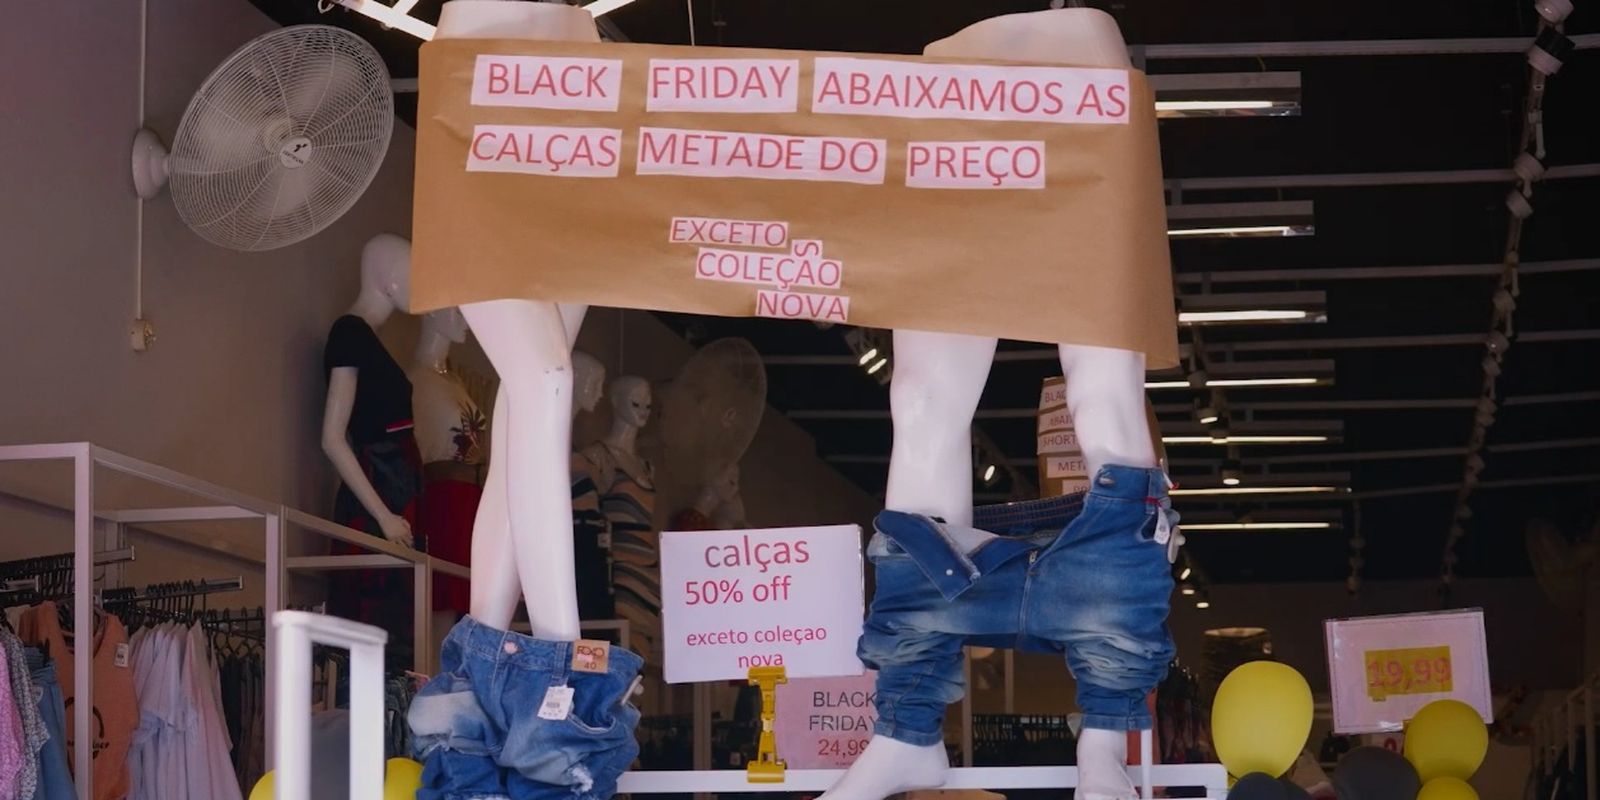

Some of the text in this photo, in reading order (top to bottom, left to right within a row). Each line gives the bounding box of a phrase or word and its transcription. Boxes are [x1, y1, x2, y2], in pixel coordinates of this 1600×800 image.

[488, 63, 1126, 117] BLACK FRIDAY ABAIXAMOS AS
[471, 132, 1041, 186] CALÇAS METADE DO PREÇO
[672, 220, 786, 246] EXCETO
[758, 293, 846, 320] NOVA
[705, 535, 810, 572] calças
[685, 576, 792, 605] 50% off
[687, 626, 827, 646] exceto coleçao
[738, 653, 784, 668] nova
[1368, 657, 1450, 689] 19,99
[813, 691, 876, 708] BLACK
